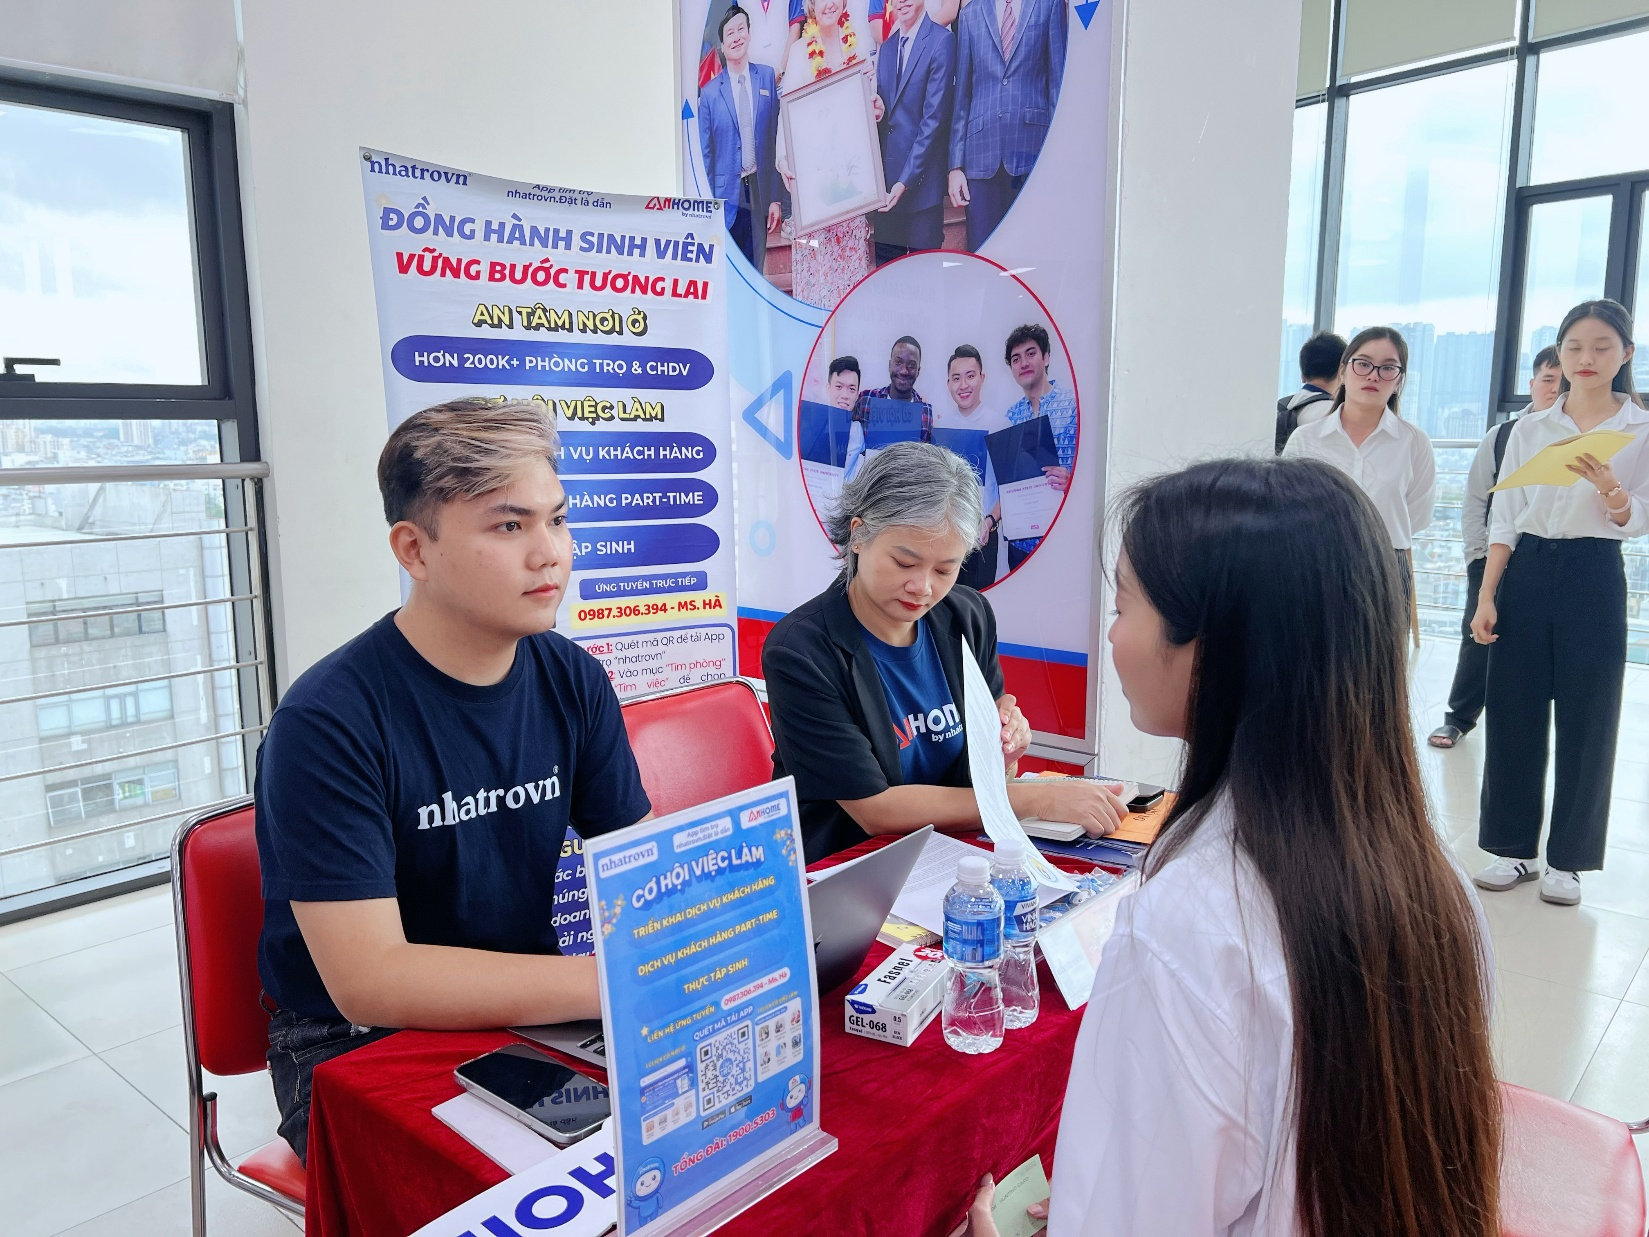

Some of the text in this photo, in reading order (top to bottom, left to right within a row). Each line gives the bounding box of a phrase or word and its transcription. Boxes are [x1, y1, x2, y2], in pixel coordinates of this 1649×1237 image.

[369, 157, 468, 186] nhatrovn
[507, 189, 578, 208] nhatrovn.Đặt
[580, 197, 590, 207] là
[532, 184, 555, 194] App
[380, 195, 715, 265] ĐỒNG HÀNH SINH VIÊN
[395, 246, 709, 300] VỮNG BƯỚC TƯƠNG LAI
[472, 302, 648, 336] AN TÂM NƠI Ở
[414, 350, 690, 376] HƠN 200K+ PHÒNG TRỌ & CHDV
[559, 396, 615, 426] VIỆC
[617, 397, 665, 422] LÀM
[569, 446, 594, 462] VỤ
[599, 443, 655, 460] KHÁCH
[659, 443, 704, 460] HÀNG
[568, 491, 704, 508] HÀNG PART-TIME
[572, 540, 635, 559] ẬP SINH
[595, 582, 617, 592] ỨNG
[652, 579, 676, 589] TRỰC
[677, 575, 697, 586] TIẾP
[577, 602, 668, 622] 0987.306.394
[677, 600, 700, 612] MS.
[614, 639, 640, 652] Quét
[641, 639, 659, 648] mã
[660, 635, 675, 647] QR
[703, 632, 725, 644] App
[617, 668, 639, 679] Vào
[641, 666, 664, 677] mục
[931, 733, 944, 742] by
[417, 774, 561, 830] nhatrovn
[601, 847, 655, 873] nhatrovn
[632, 841, 765, 908] CƠ HỘI VIỆC LÀM
[662, 910, 685, 928] KHAI
[685, 902, 708, 919] DỊCH
[708, 897, 721, 910] VỤ
[722, 884, 751, 904] KHÁCH
[751, 875, 775, 892] HÀNG
[638, 961, 662, 976] DỊCH
[662, 952, 676, 965] VỤ
[677, 940, 708, 960] KHÁCH
[735, 909, 779, 935] PART-TIME
[683, 958, 749, 994] THỰC TẬP SINH
[693, 1026, 713, 1040] QUÉT
[739, 1006, 754, 1019] APP
[848, 1014, 887, 1033] GEL-068
[727, 1107, 777, 1144] 1900.5303
